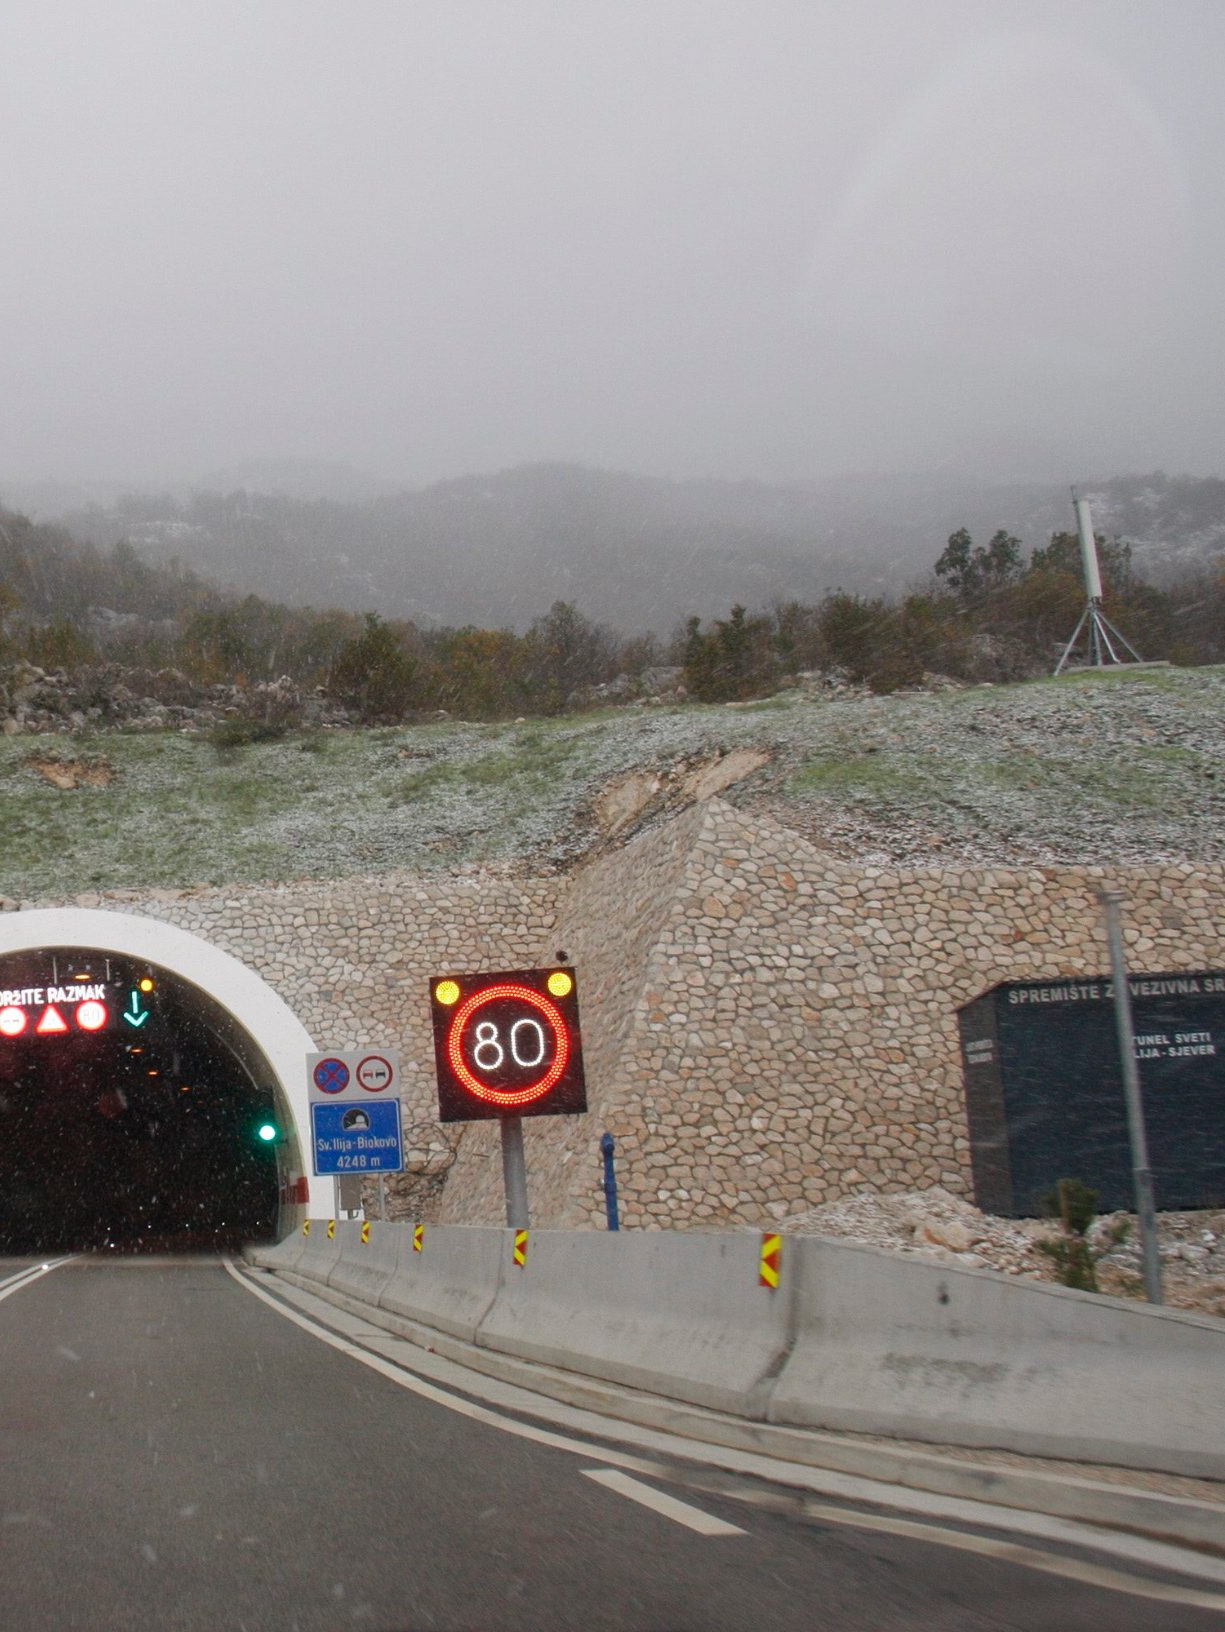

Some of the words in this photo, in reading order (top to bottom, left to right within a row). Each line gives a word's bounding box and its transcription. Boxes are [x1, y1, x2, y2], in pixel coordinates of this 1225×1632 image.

[47, 984, 106, 1004] RAZMAK
[1008, 984, 1101, 1004] SPREMIŠTE
[1128, 980, 1201, 996] VEZIVNA
[474, 1018, 545, 1070] 80
[1174, 1032, 1211, 1044] SVETI
[1168, 1045, 1216, 1057] SJEVER
[318, 1138, 332, 1152] Sv.
[337, 1155, 367, 1168] 4248
[370, 1157, 380, 1167] m
